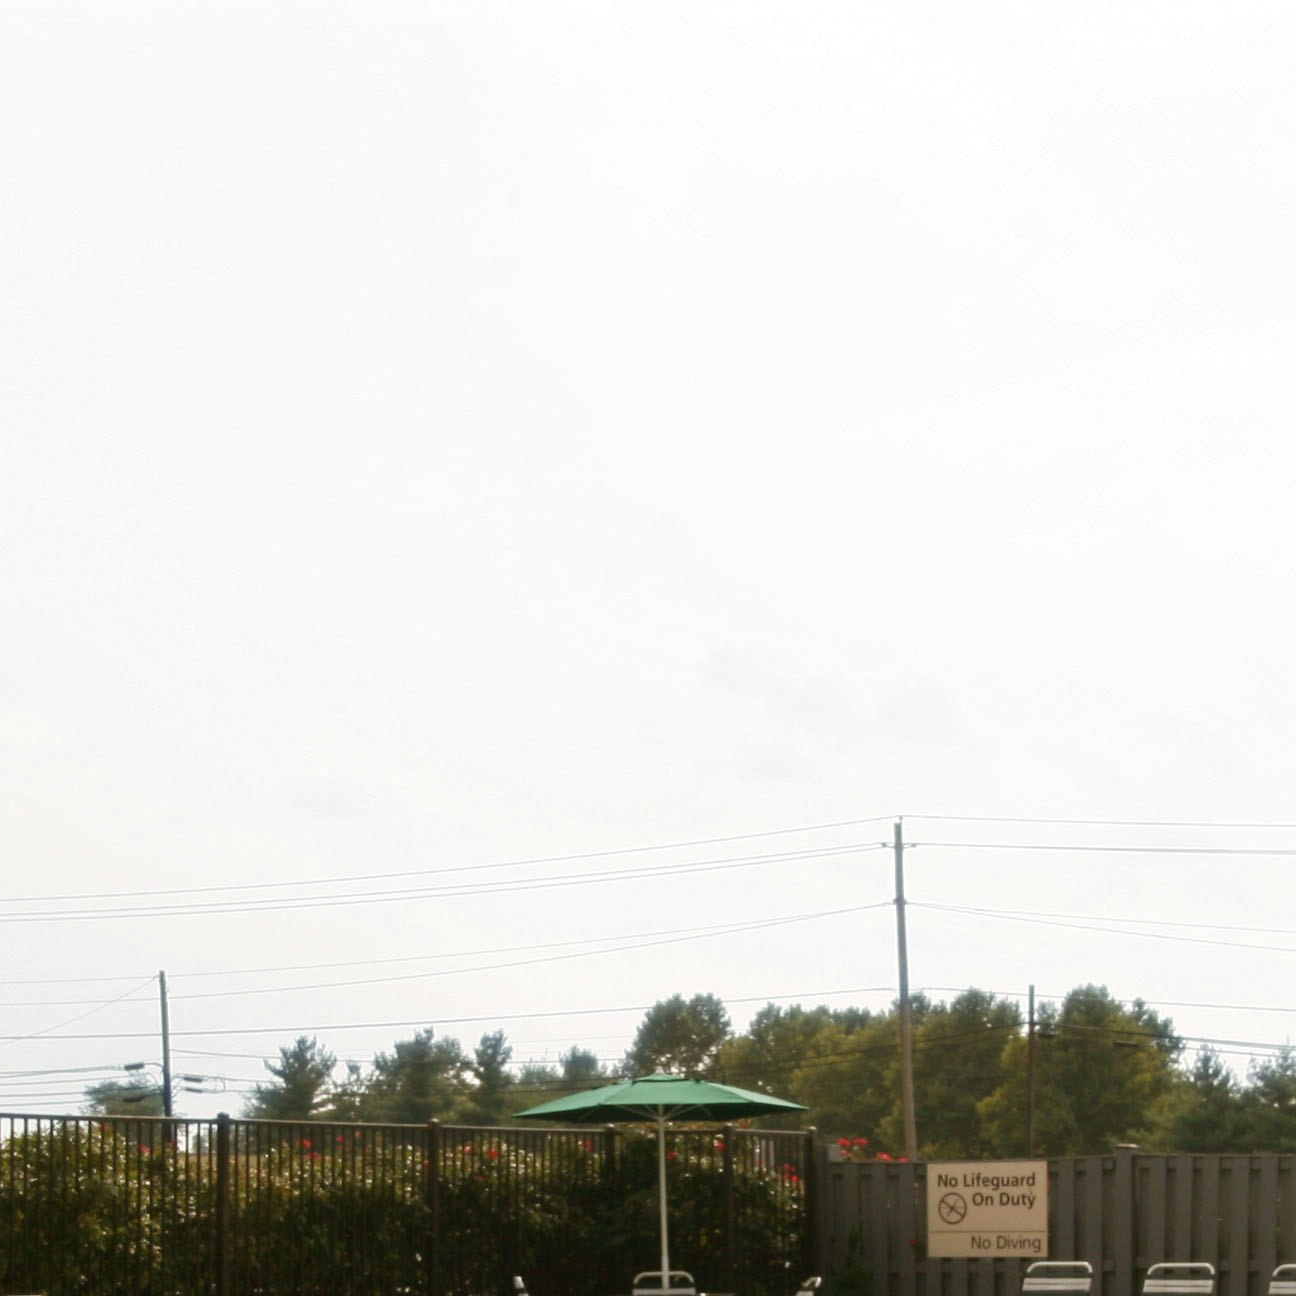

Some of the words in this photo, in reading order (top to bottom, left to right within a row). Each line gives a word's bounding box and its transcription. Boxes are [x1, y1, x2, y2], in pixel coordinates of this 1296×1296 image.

[937, 1174, 958, 1188] No
[963, 1172, 1036, 1190] Lifeguard
[972, 1192, 994, 1206] On
[999, 1192, 1036, 1210] Duty
[971, 1236, 992, 1249] No
[996, 1235, 1041, 1252] Diving
